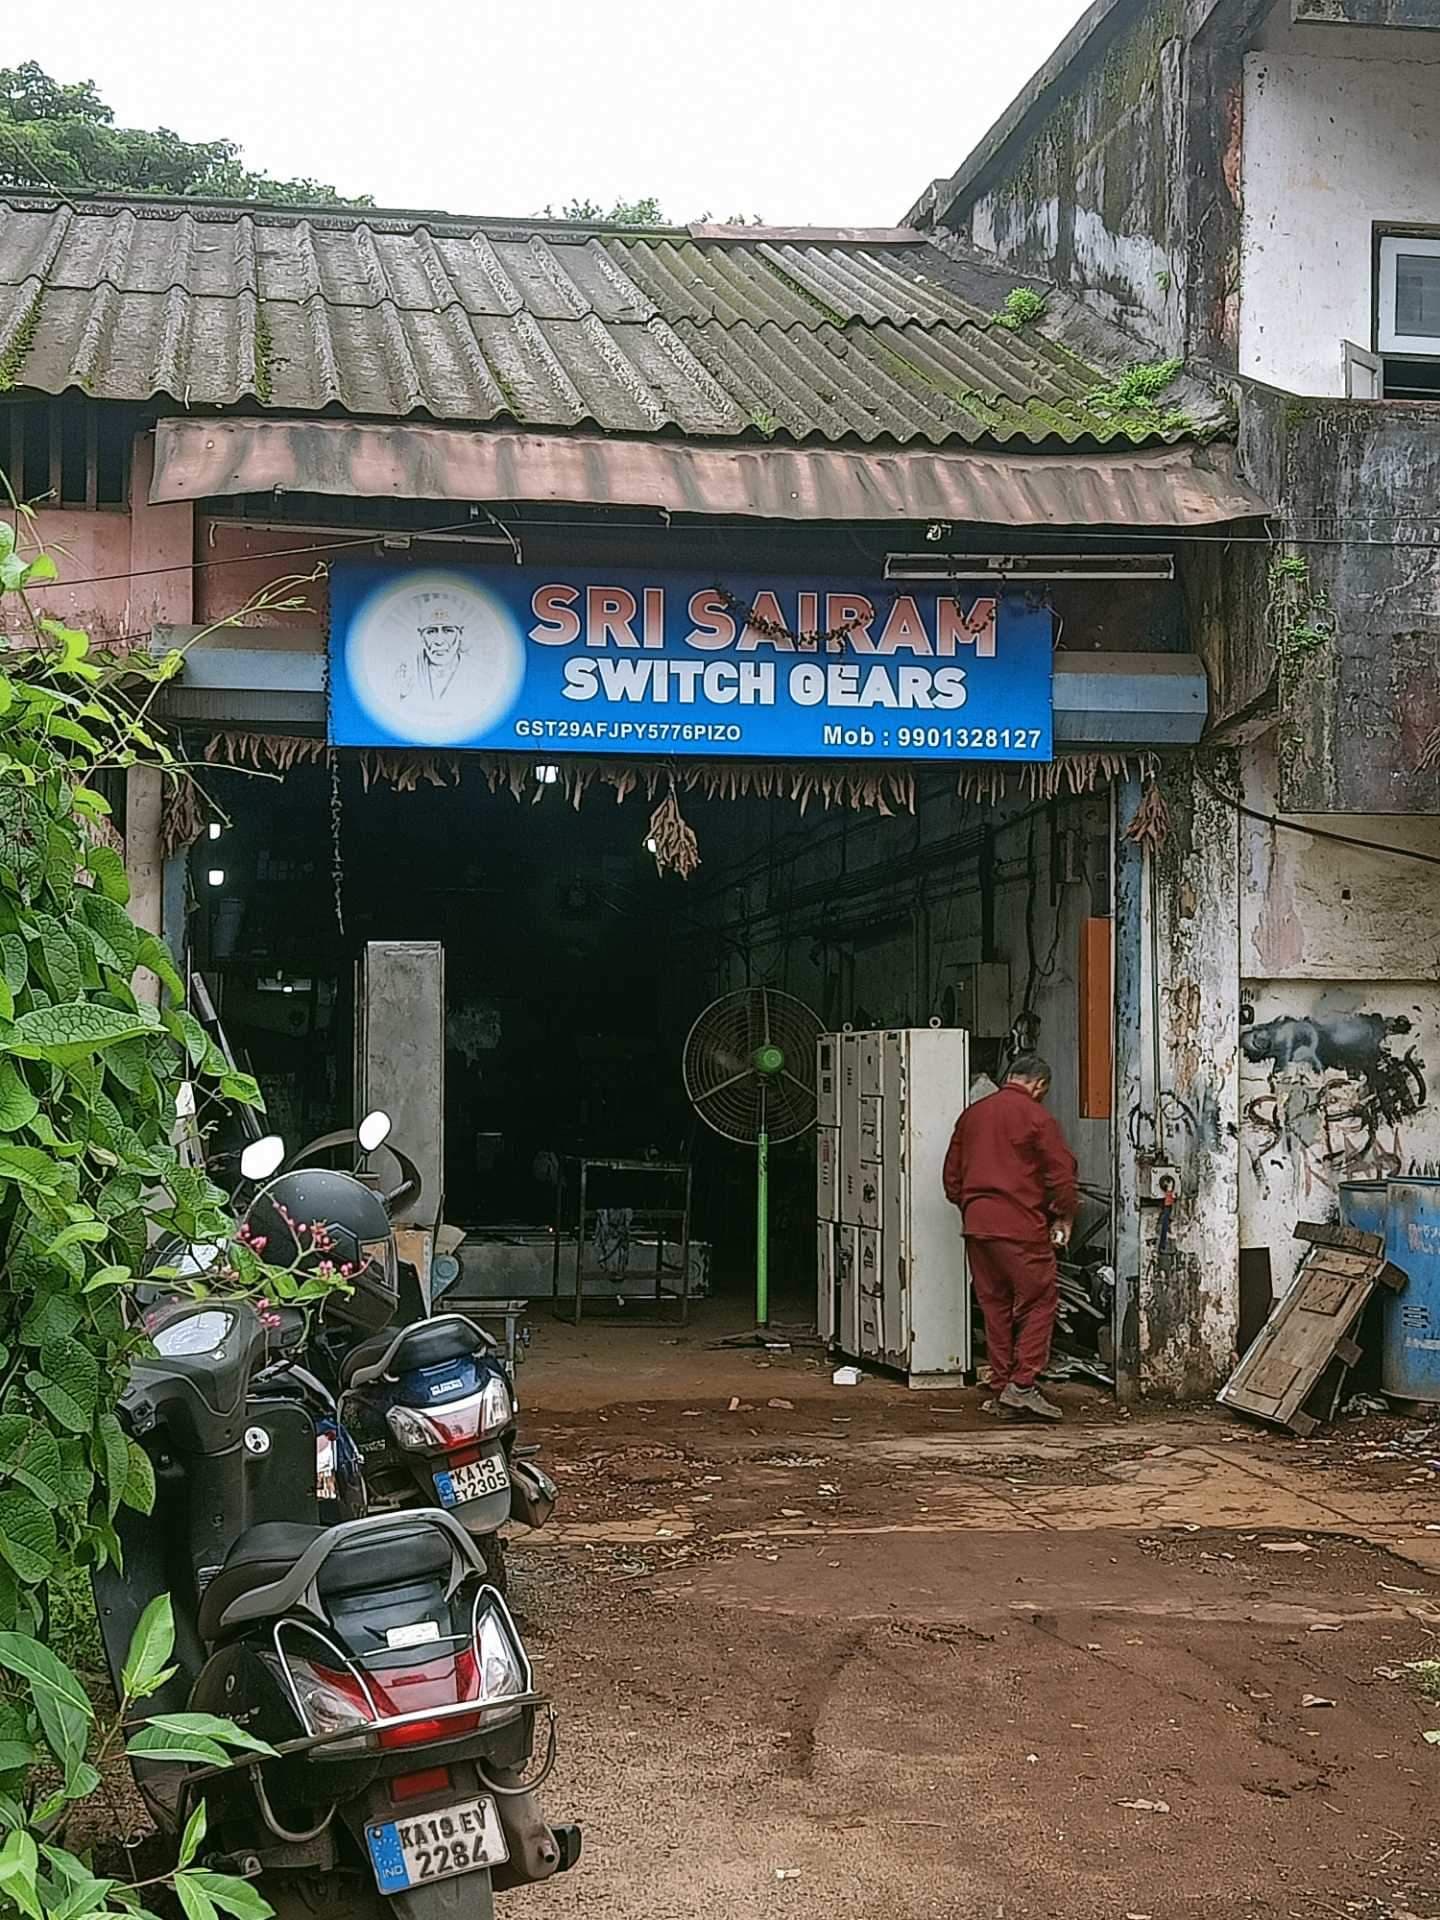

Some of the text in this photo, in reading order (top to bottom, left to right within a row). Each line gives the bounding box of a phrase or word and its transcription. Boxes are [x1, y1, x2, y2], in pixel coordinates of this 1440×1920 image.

[528, 584, 997, 657] SRI SAIRAM
[561, 657, 967, 710] SWITCH GEARS
[823, 725, 875, 747] Mob
[898, 727, 1042, 749] 9901328127
[415, 1834, 490, 1879] 2284
